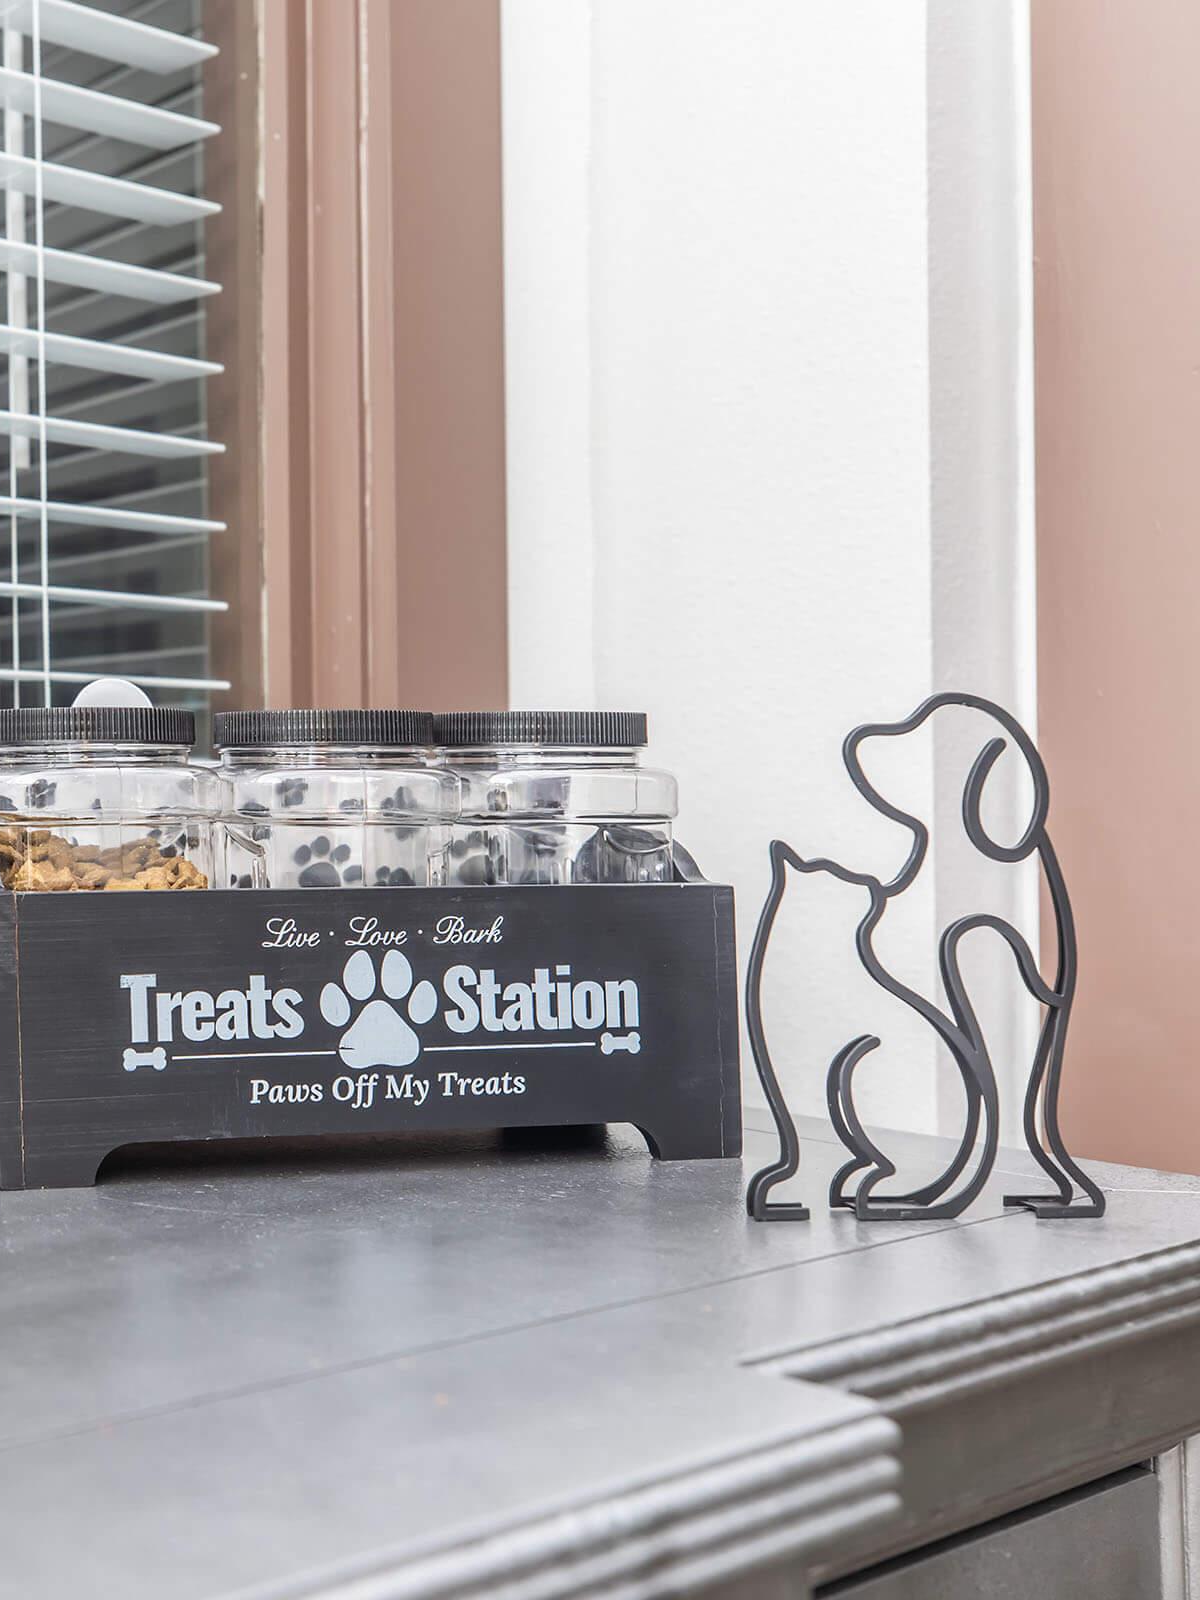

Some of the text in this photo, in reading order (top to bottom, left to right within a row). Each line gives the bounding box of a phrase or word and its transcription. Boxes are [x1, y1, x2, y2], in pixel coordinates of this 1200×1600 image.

[261, 915, 504, 948] Live Love Bark
[120, 964, 641, 1043] Treats Station
[249, 1072, 527, 1108] Paws Off My Treats
